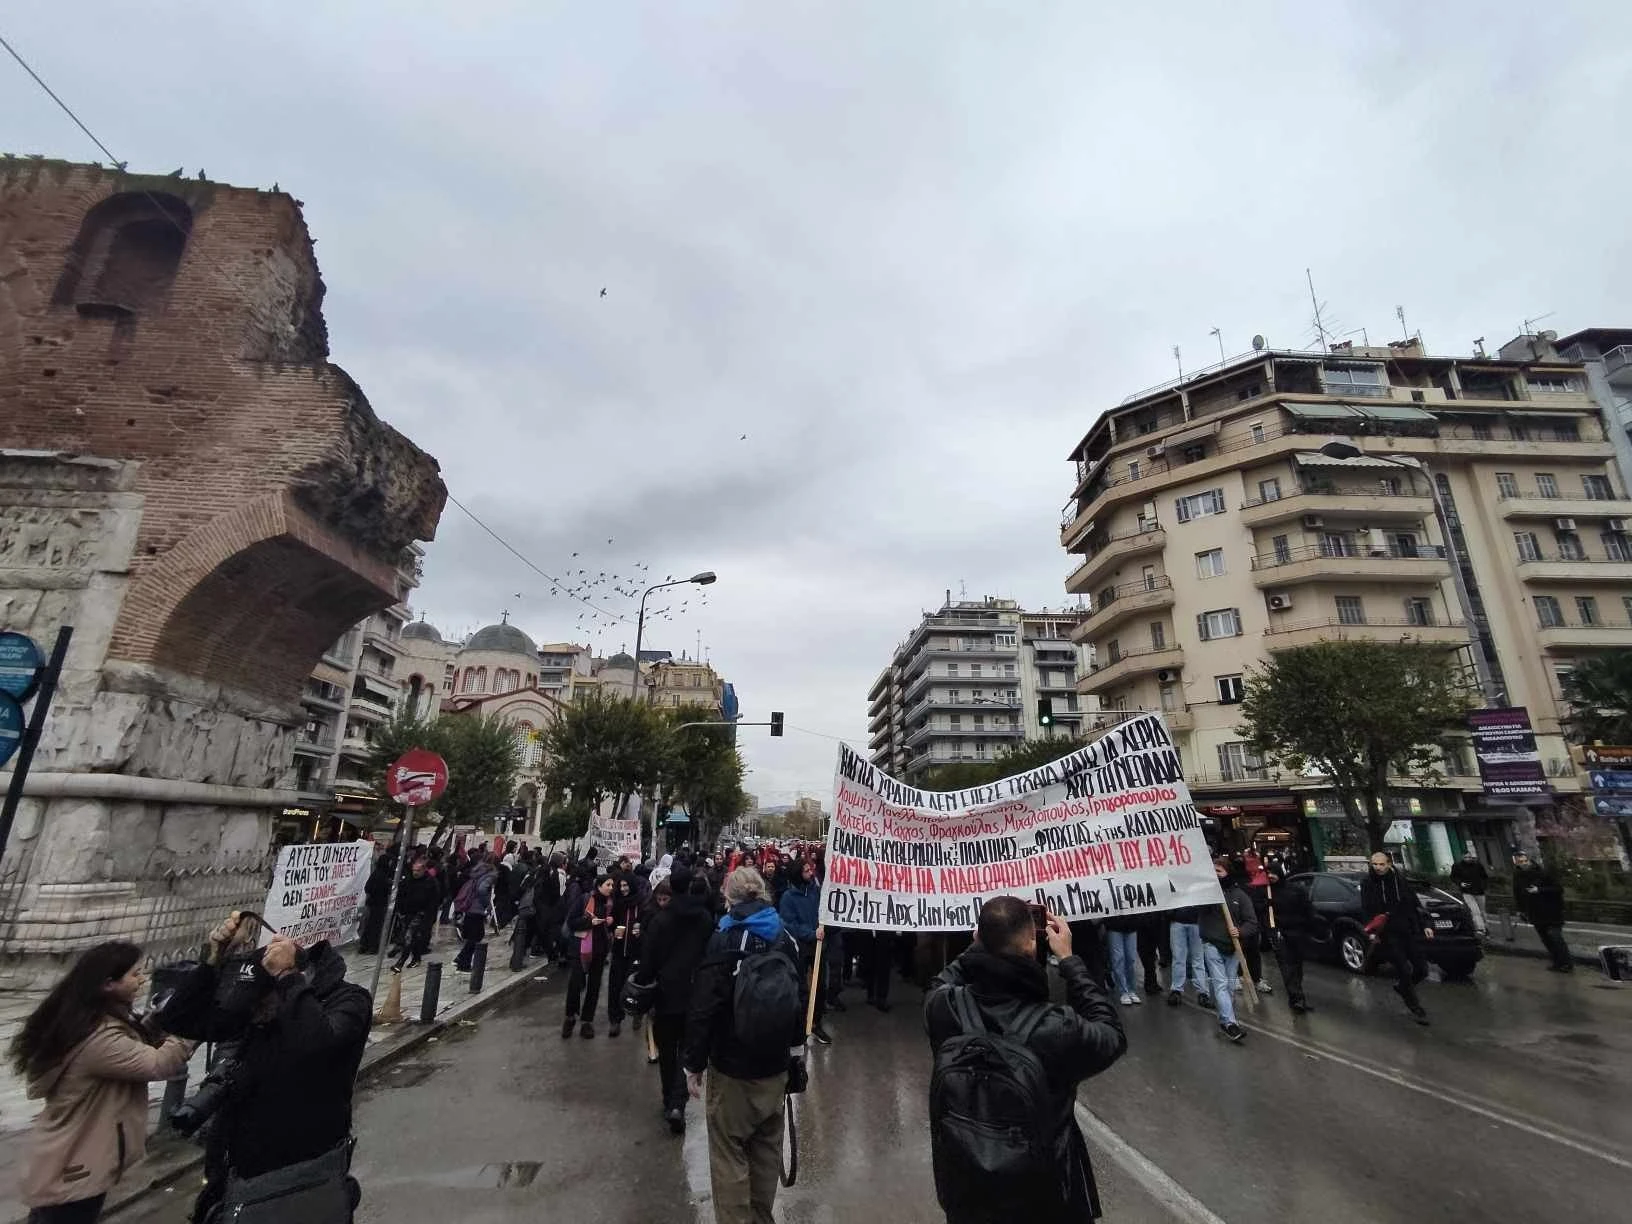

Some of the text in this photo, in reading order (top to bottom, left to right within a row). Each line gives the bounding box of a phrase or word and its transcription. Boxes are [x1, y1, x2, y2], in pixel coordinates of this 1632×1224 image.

[840, 745, 874, 791] ΚΑΜΙΑ
[876, 772, 924, 807] ΣΦΑΙΡΑ
[929, 793, 957, 811] ΔΕΝ
[960, 783, 1004, 808] ΕΠΕΣΕ
[1008, 765, 1060, 795] ΤΥΧΑΙΑ
[1060, 746, 1099, 779] ΚΑΤΩ
[1116, 716, 1171, 753] ΧΕΡΙΑ
[1066, 772, 1095, 800] ΑΠΟ
[1095, 764, 1117, 793] ΤΗ
[881, 839, 942, 866] ΚΥΒΕΡΝΗΣΗ
[960, 836, 1020, 865] ΠΟΛΙΤΙΚΕΣ
[1035, 821, 1094, 852] ΦΤΩΧΕΙΑΣ
[1123, 803, 1200, 838] ΚΑΤΑΣΤΟΛΗΣ
[287, 845, 360, 867] ΑΥΤΕΣ ΟΙ ΜΕΡΕΣ
[830, 855, 871, 888] ΚΑΜΙΑ
[875, 862, 912, 893] ΣΚΕΨΗ
[916, 867, 936, 895] ΓΙΑ
[1116, 840, 1143, 870] ΤΟΥ
[284, 868, 310, 887] ΕΙΝΑΙ
[314, 866, 331, 882] ΤΟΥ
[282, 883, 339, 907] ΔΕΝ ΞΕΧΝΑΜΕ
[301, 903, 317, 919] ΔΕΝ
